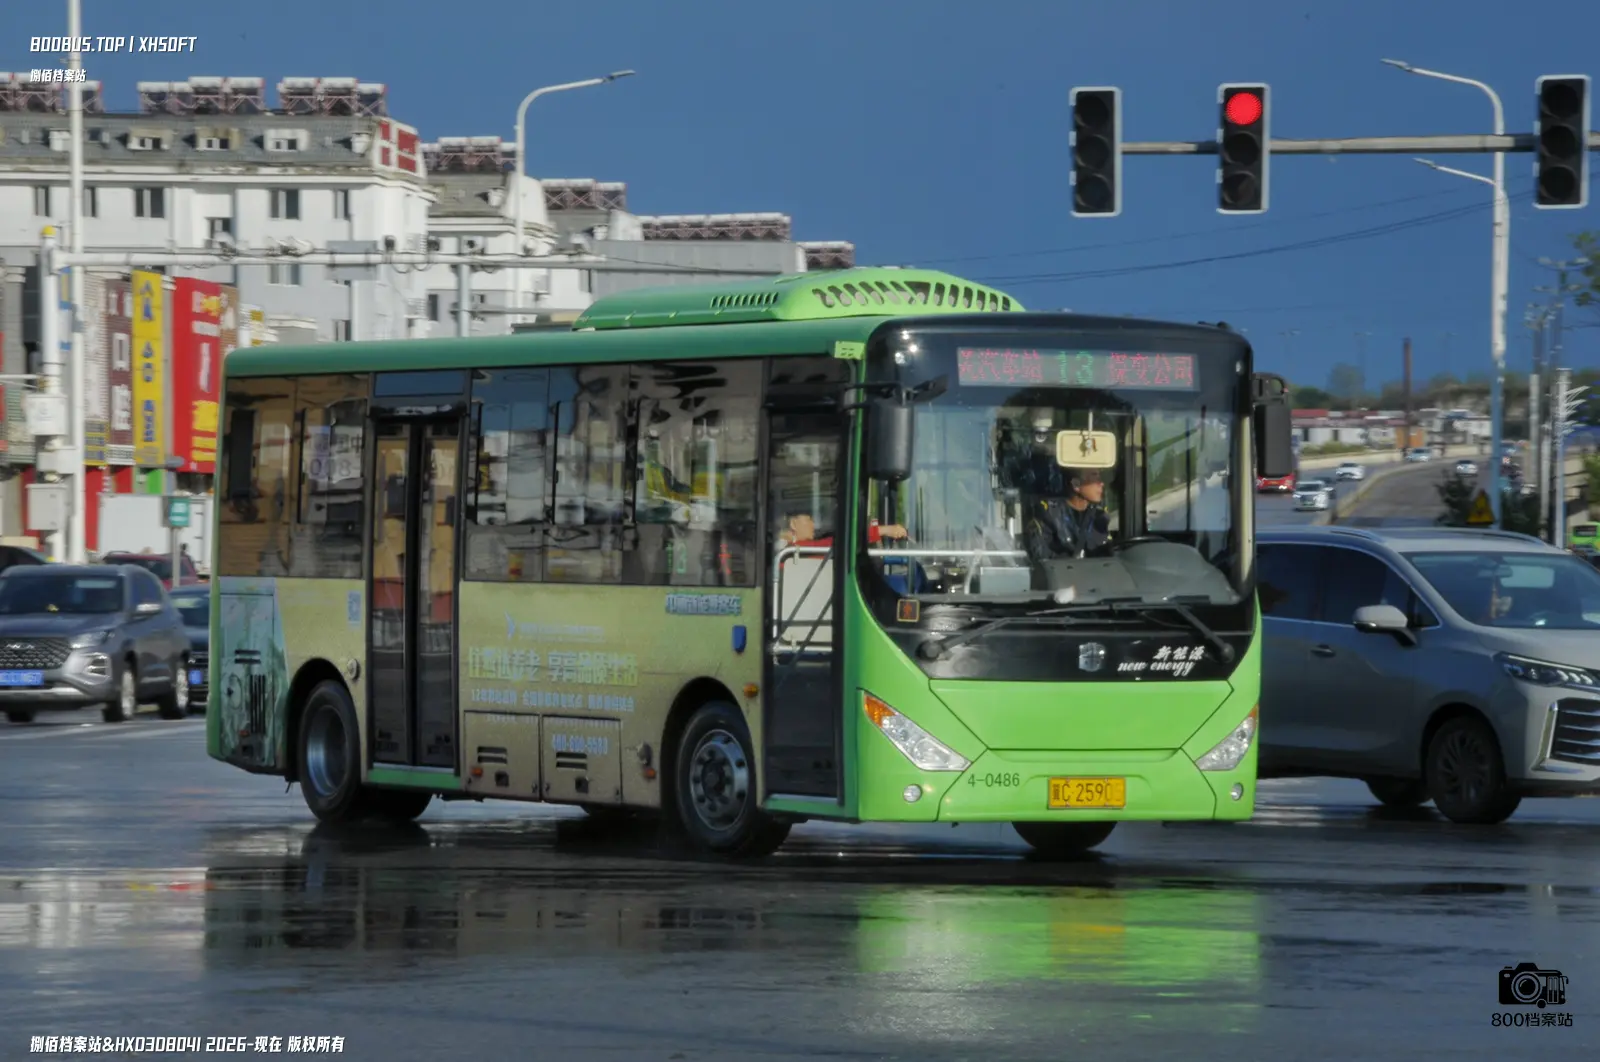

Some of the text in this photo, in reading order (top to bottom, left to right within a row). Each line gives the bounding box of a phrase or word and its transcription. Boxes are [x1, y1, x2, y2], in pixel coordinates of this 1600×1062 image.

[1054, 351, 1094, 385] 13
[1152, 645, 1205, 661] 新能源
[1117, 662, 1195, 677] new energy
[967, 772, 1020, 788] 4-0486
